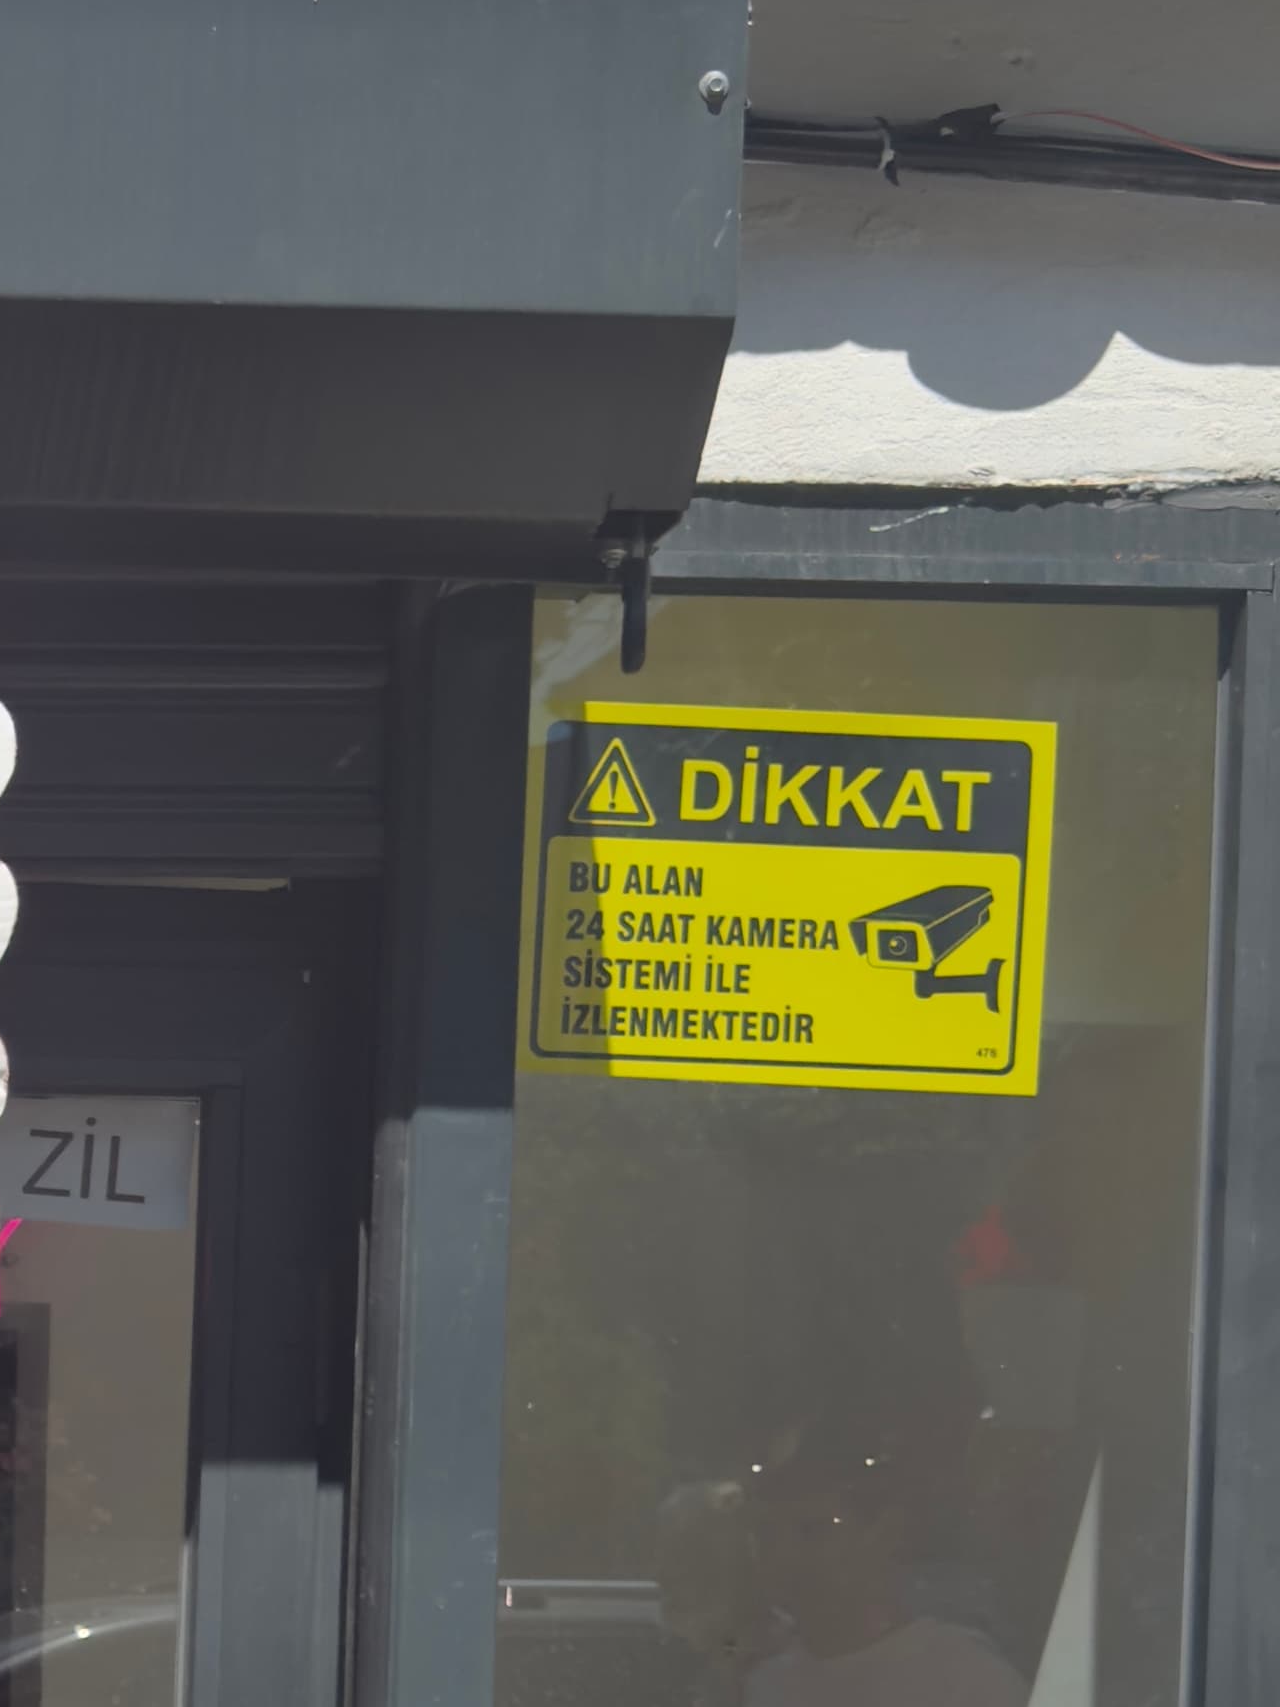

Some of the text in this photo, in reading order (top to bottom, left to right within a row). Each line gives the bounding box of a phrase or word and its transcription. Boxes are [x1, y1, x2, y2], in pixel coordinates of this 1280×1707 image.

[680, 746, 991, 832] DİKKAT
[569, 861, 704, 897] BU ALAN
[566, 908, 839, 950] 24 SAAT KAMERA
[563, 949, 751, 994] SİSTEMİ İLE
[560, 996, 814, 1044] İZLENMEKTEDİR
[21, 1116, 146, 1204] ZİL
